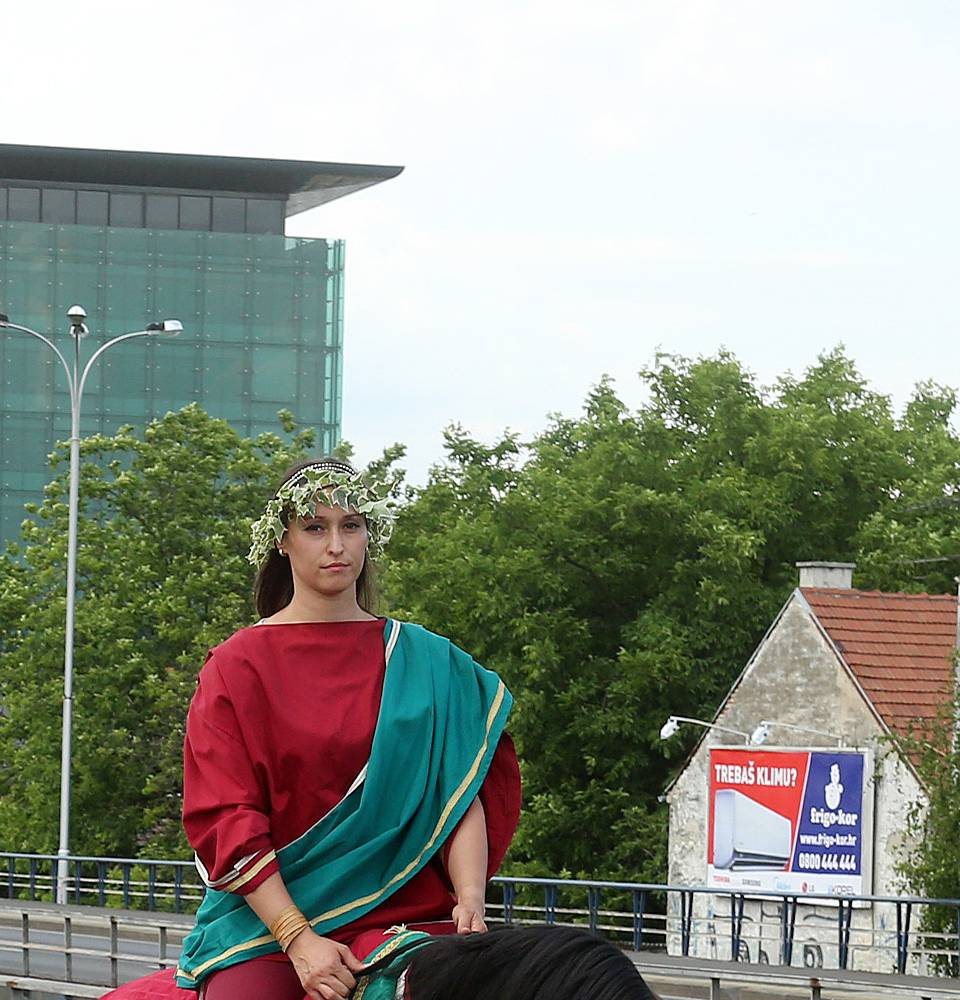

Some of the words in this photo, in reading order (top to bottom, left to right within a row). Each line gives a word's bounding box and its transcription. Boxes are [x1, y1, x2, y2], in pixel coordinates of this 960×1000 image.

[714, 760, 756, 786] TREBAŠ
[756, 766, 798, 787] KLIMU?
[810, 807, 858, 828] frigo-kor
[799, 833, 857, 848] www.frigo-kor.hr
[798, 852, 821, 870] 0800
[821, 853, 839, 870] 444
[839, 854, 857, 871] 444
